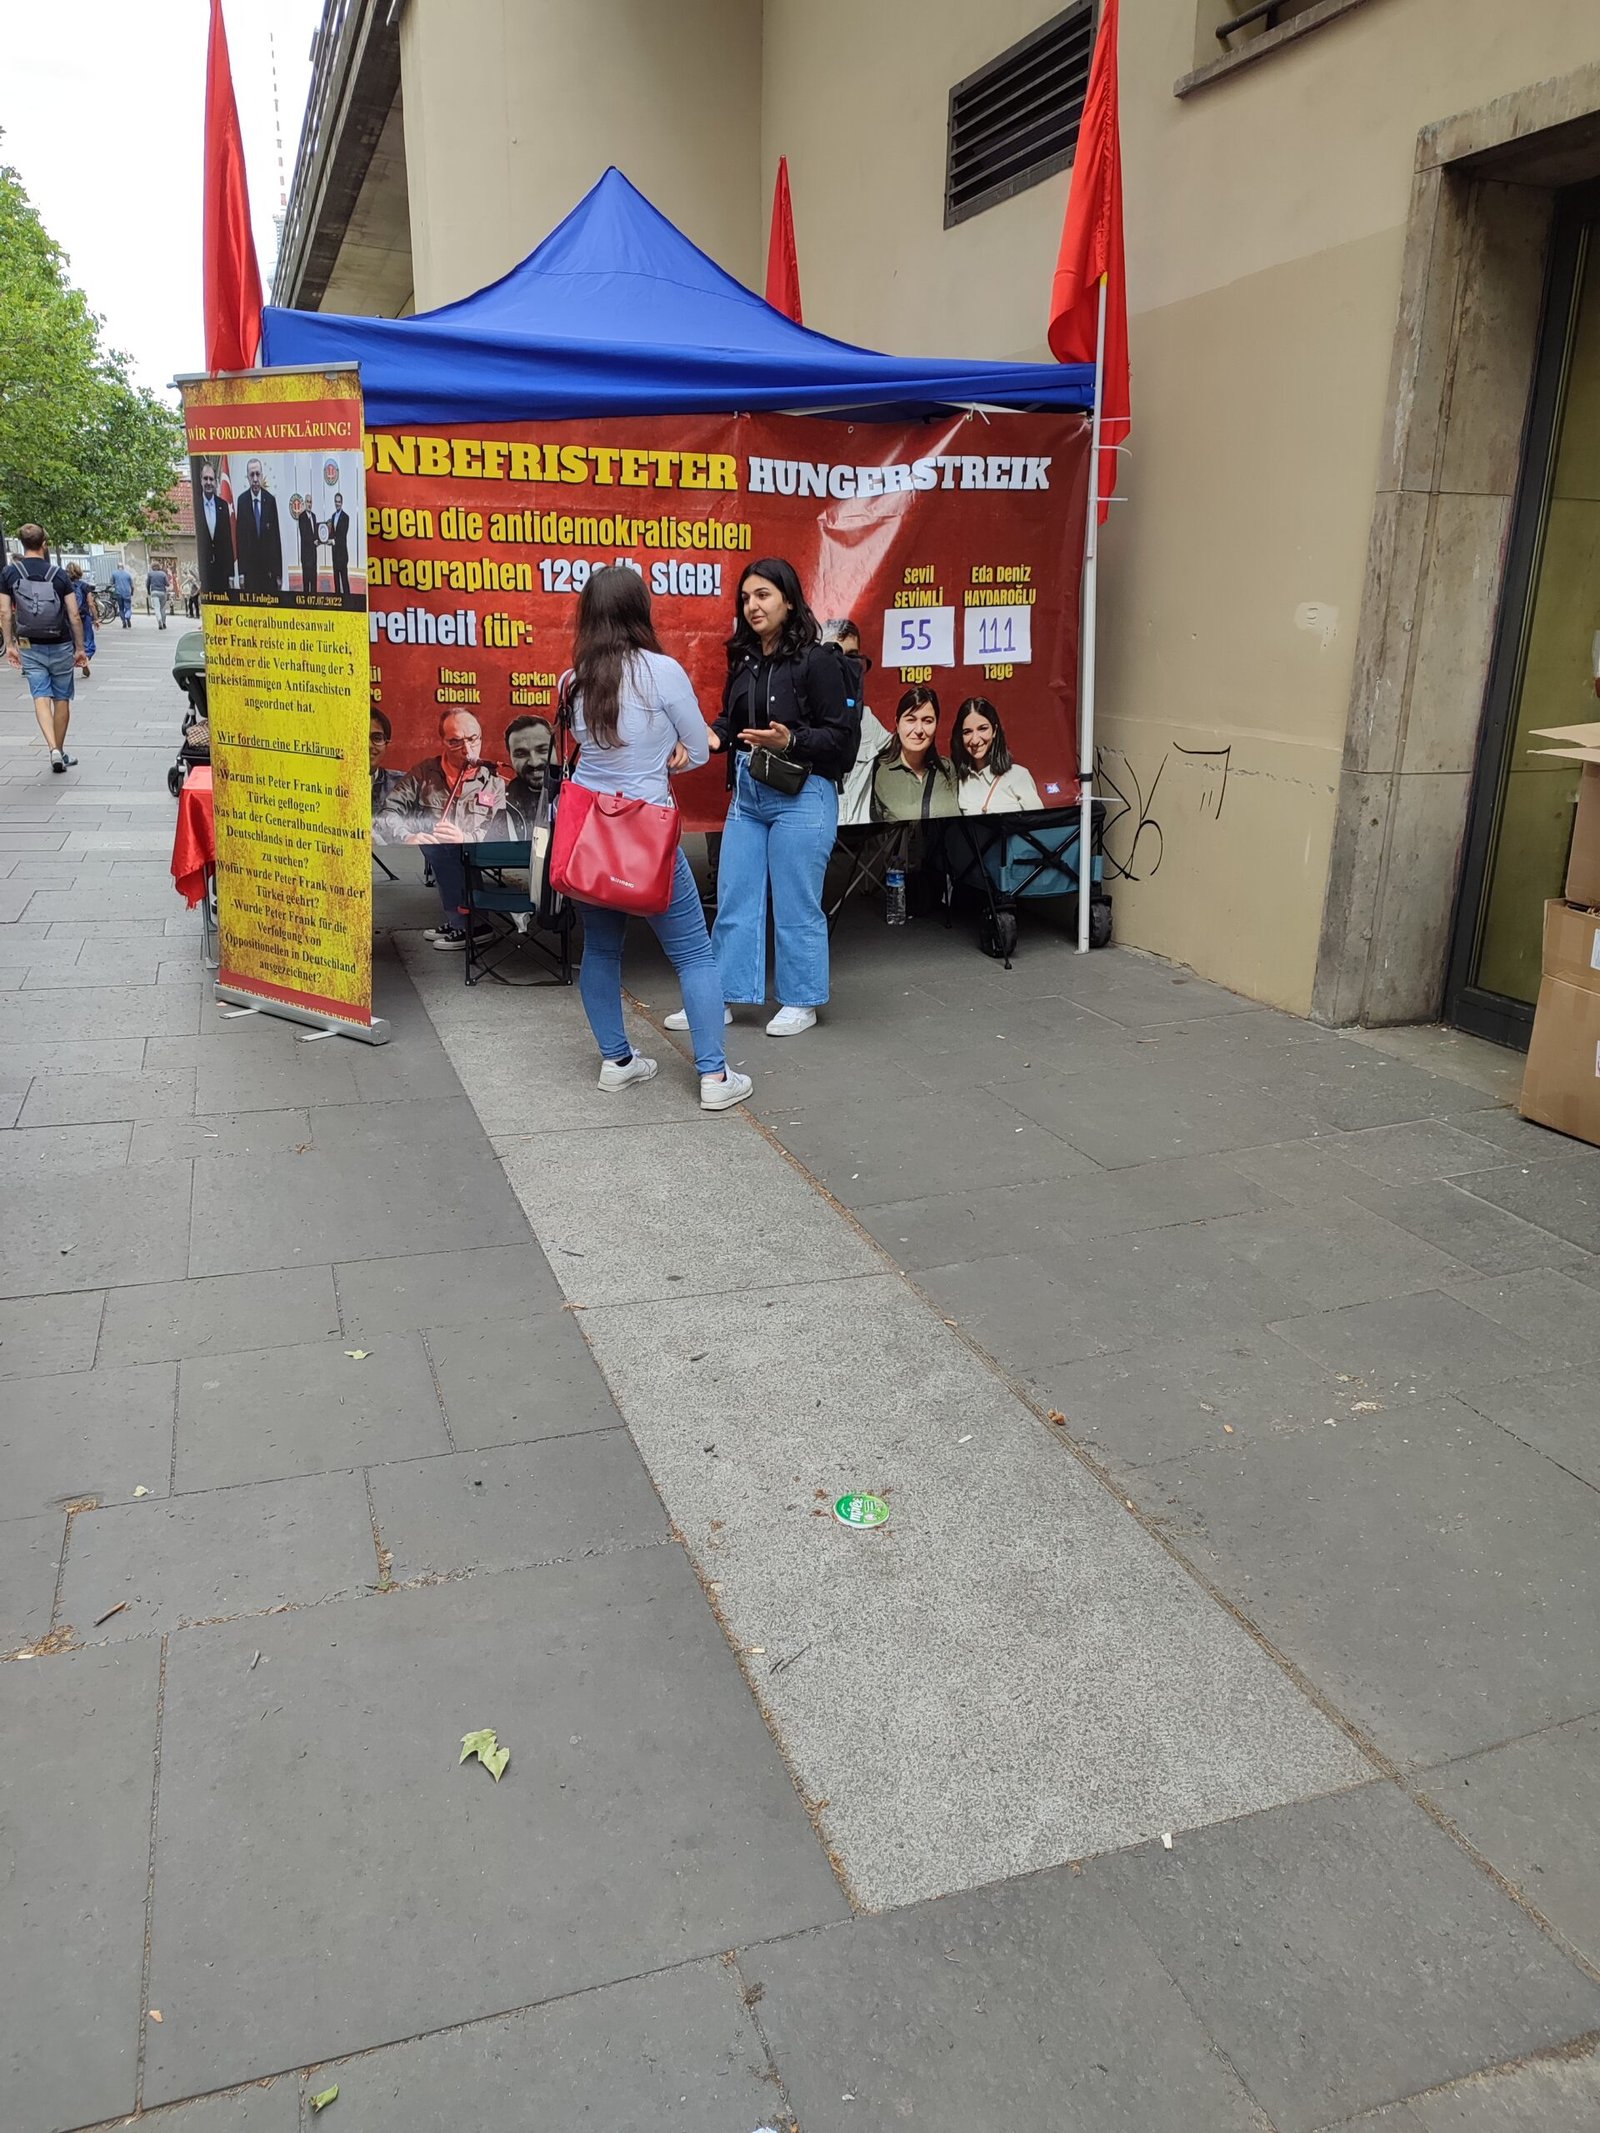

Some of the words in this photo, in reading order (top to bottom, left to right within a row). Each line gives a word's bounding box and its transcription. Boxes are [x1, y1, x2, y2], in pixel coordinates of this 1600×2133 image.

[210, 425, 262, 440] FORDERN
[264, 419, 351, 438] AUFKLÄRUNG!
[748, 455, 1052, 499] HUNGERSTREIK
[367, 507, 433, 541] egen
[441, 507, 482, 541] die
[490, 510, 751, 550] antidemokratischen
[368, 556, 532, 592] aragraphen
[651, 559, 722, 596] StGB!
[972, 564, 993, 583] Eda
[996, 564, 1032, 583] Deniz
[894, 586, 944, 608] SEVİMLİ
[965, 584, 1036, 607] HAYDAROĞLU
[216, 614, 232, 627] Der
[236, 615, 334, 632] Generalbundesanwalt
[369, 608, 477, 647] reiheit
[483, 612, 534, 648] für:
[900, 618, 932, 650] 55
[978, 616, 1016, 654] 111
[205, 632, 227, 646] Peter
[230, 634, 257, 648] Frank
[260, 638, 284, 650] reiste
[287, 639, 296, 651] in
[300, 639, 314, 652] die
[247, 658, 256, 668] er
[258, 656, 270, 669] die
[273, 657, 326, 676] Verhaftung
[328, 661, 344, 675] der
[348, 663, 354, 675] 3
[900, 666, 932, 683] Tage
[984, 664, 1013, 680] Tage
[208, 672, 281, 691] türkeistämmigen
[285, 680, 351, 696] Antifaschisten
[437, 687, 480, 703] Cibelik
[245, 696, 293, 712] angeordnet
[297, 702, 315, 713] hat.
[512, 688, 550, 706] Küpeli
[217, 730, 235, 743] Wir
[238, 733, 270, 748] fordern
[273, 738, 290, 750] eine
[294, 740, 344, 757] Erklärung:
[256, 774, 266, 785] ist
[268, 775, 290, 790] Peter
[294, 778, 322, 794] Frank
[325, 784, 332, 795] in
[335, 785, 349, 798] die
[248, 791, 275, 806] Türkei
[278, 797, 320, 814] geflogen?
[232, 808, 246, 820] hat
[250, 810, 263, 823] der
[265, 813, 365, 839] Generalbundesanwalt
[226, 826, 282, 846] Deutschlands
[285, 838, 294, 849] in
[297, 836, 312, 849] der
[315, 839, 344, 856] Türkei
[262, 853, 272, 862] zu
[274, 854, 309, 869] suchen?
[246, 867, 272, 880] wurde
[274, 871, 296, 886] Peter
[299, 876, 327, 892] Frank
[329, 884, 344, 896] von
[347, 886, 365, 899] der
[256, 885, 284, 902] Türkei
[286, 892, 320, 909] geehrt?
[231, 899, 262, 915] -Wurde
[265, 906, 286, 920] Peter
[289, 911, 316, 927] Frank
[319, 916, 332, 931] für
[334, 920, 347, 934] die
[257, 921, 303, 944] Verfolgung
[305, 936, 321, 946] von
[225, 932, 288, 957] Oppositionellen
[291, 947, 300, 958] in
[302, 951, 356, 974] Deutschland
[260, 962, 322, 983] ausgezeichnet?
